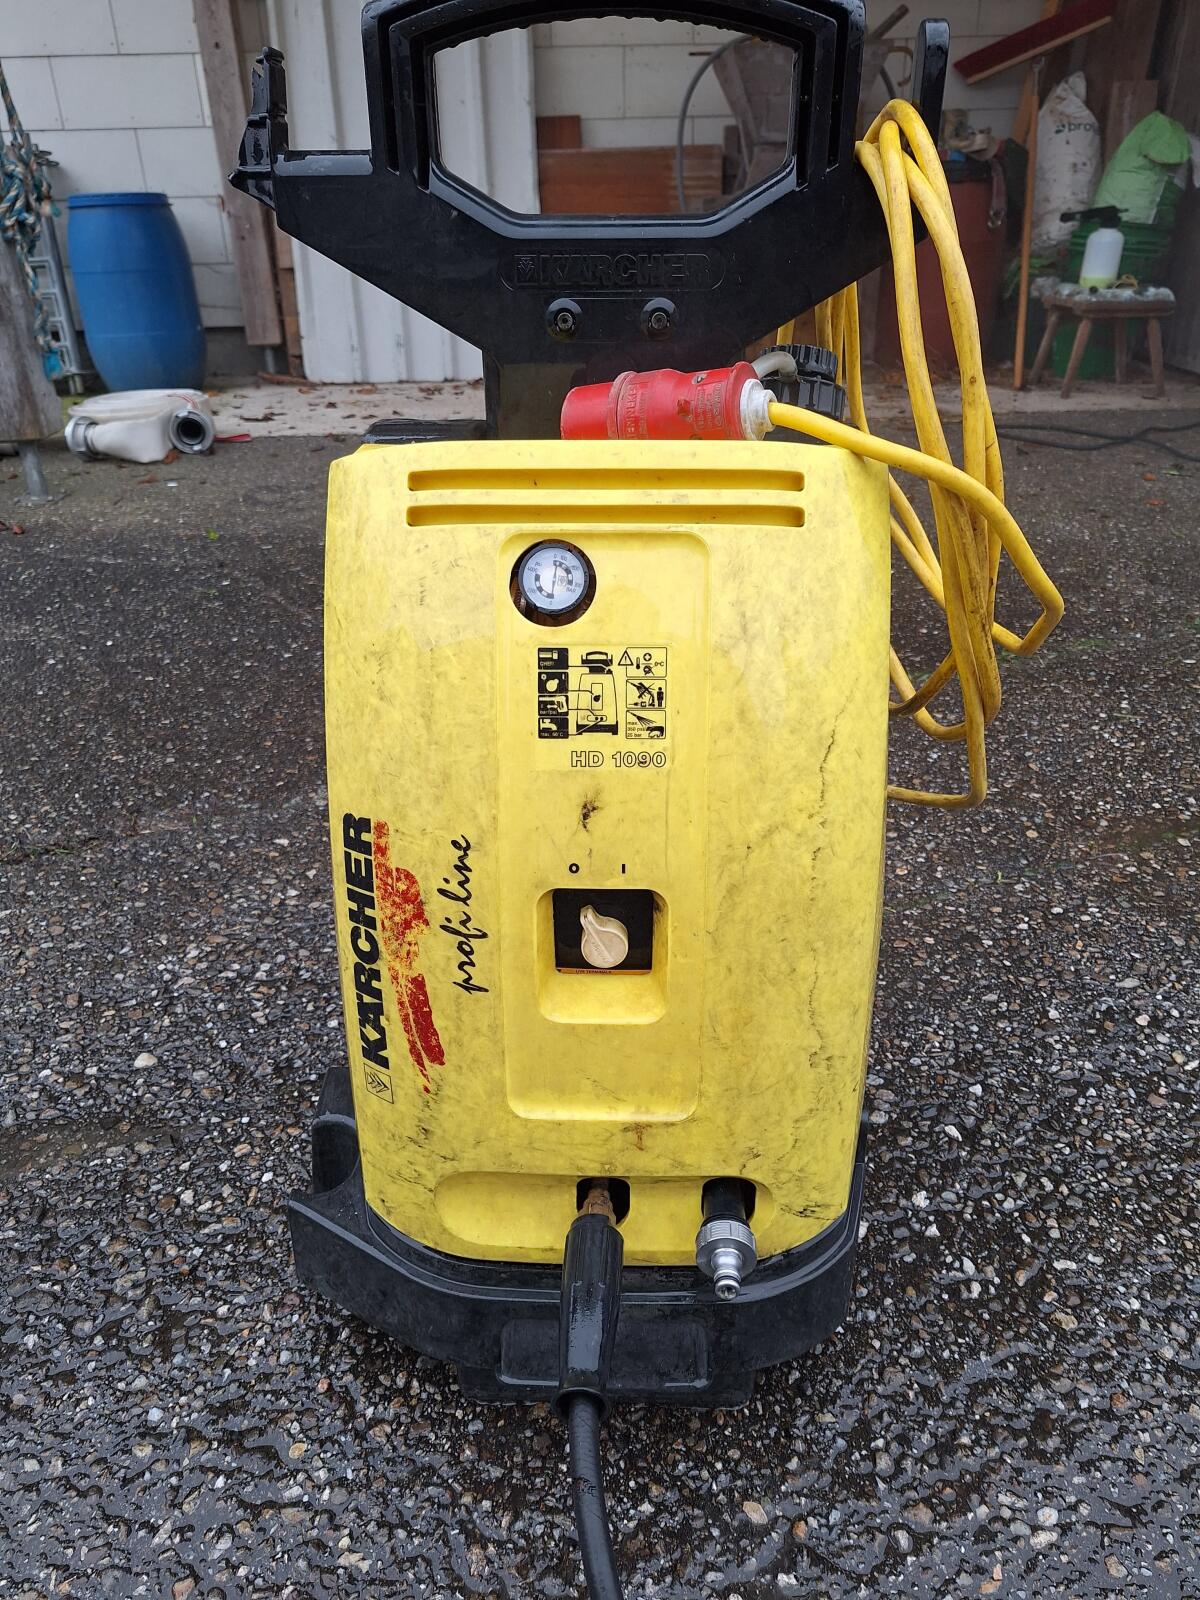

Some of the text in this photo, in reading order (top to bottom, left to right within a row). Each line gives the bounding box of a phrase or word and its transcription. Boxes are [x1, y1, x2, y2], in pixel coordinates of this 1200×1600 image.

[571, 751, 667, 768] HD 1090
[437, 834, 472, 906] line
